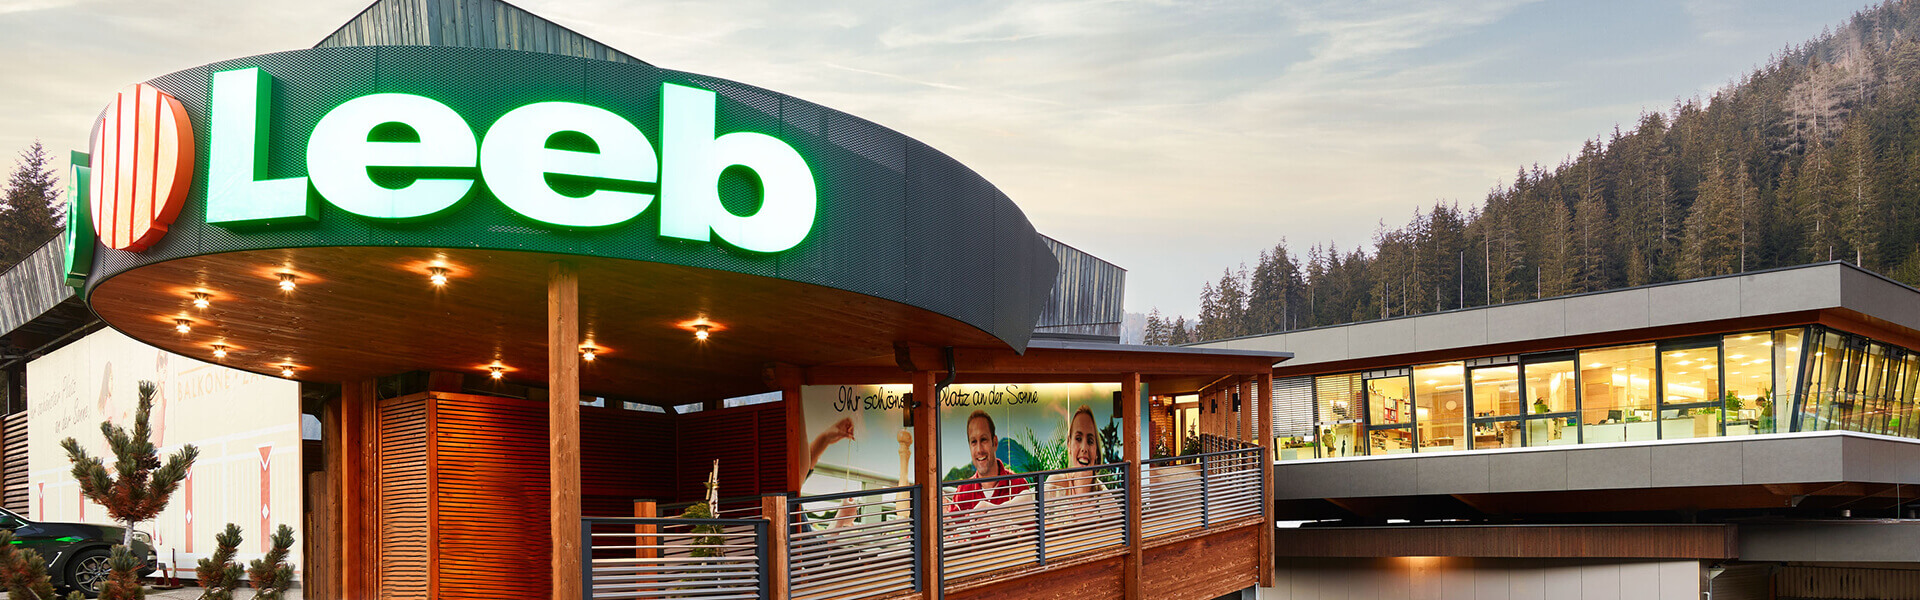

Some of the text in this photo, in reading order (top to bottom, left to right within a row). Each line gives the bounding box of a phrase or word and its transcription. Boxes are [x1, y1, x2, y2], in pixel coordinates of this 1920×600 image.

[205, 66, 817, 254] Leeb
[177, 368, 229, 402] BALKONE
[833, 385, 860, 412] Ihr
[864, 386, 905, 411] schöns
[973, 390, 987, 406] an
[989, 385, 1003, 406] der
[1006, 384, 1039, 406] Sonne
